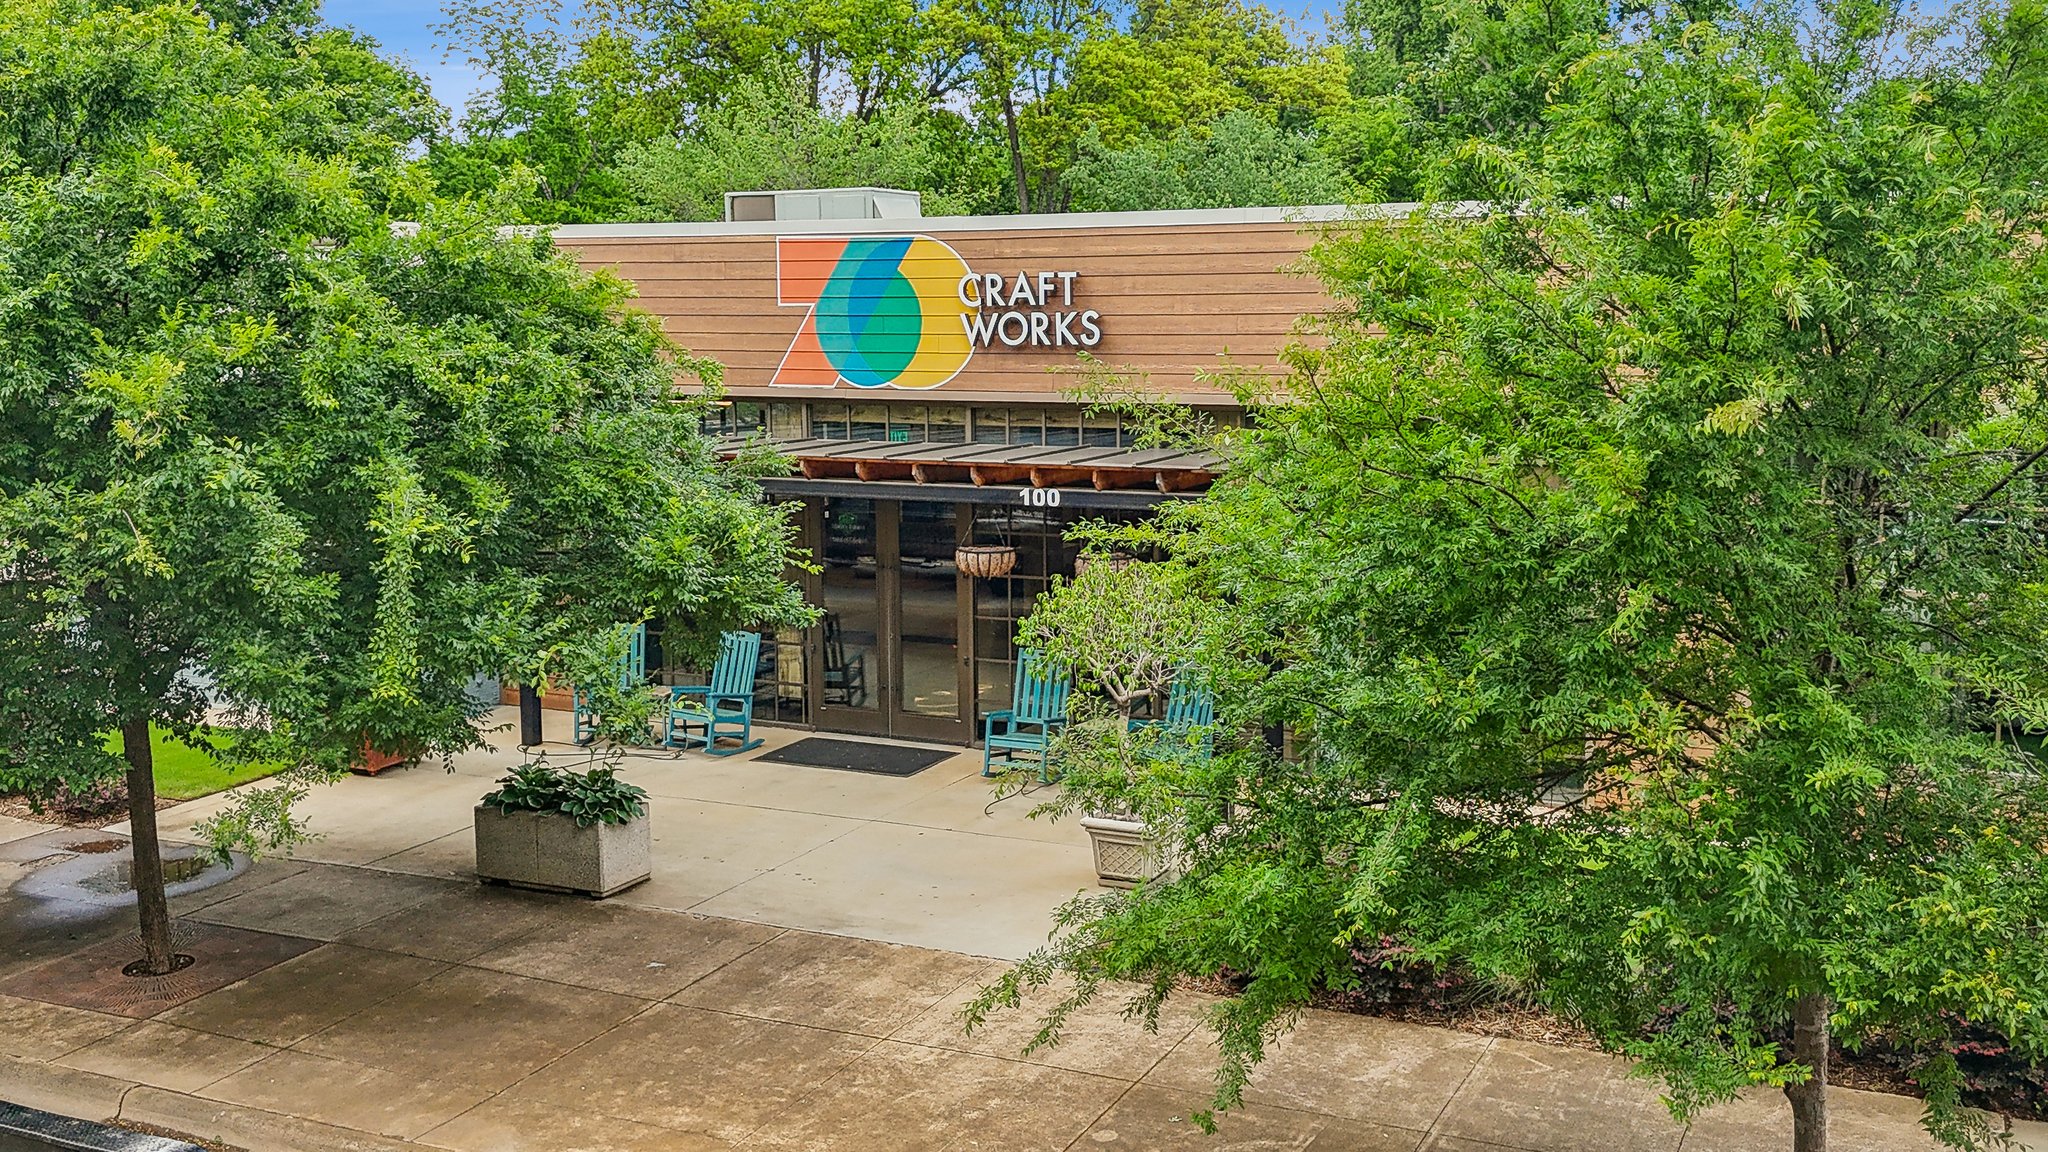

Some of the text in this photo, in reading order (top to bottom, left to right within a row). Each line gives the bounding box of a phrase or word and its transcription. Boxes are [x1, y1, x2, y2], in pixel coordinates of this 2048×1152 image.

[958, 270, 1078, 308] CRAFT
[960, 311, 1102, 347] WORKS
[1019, 488, 1060, 507] 100
